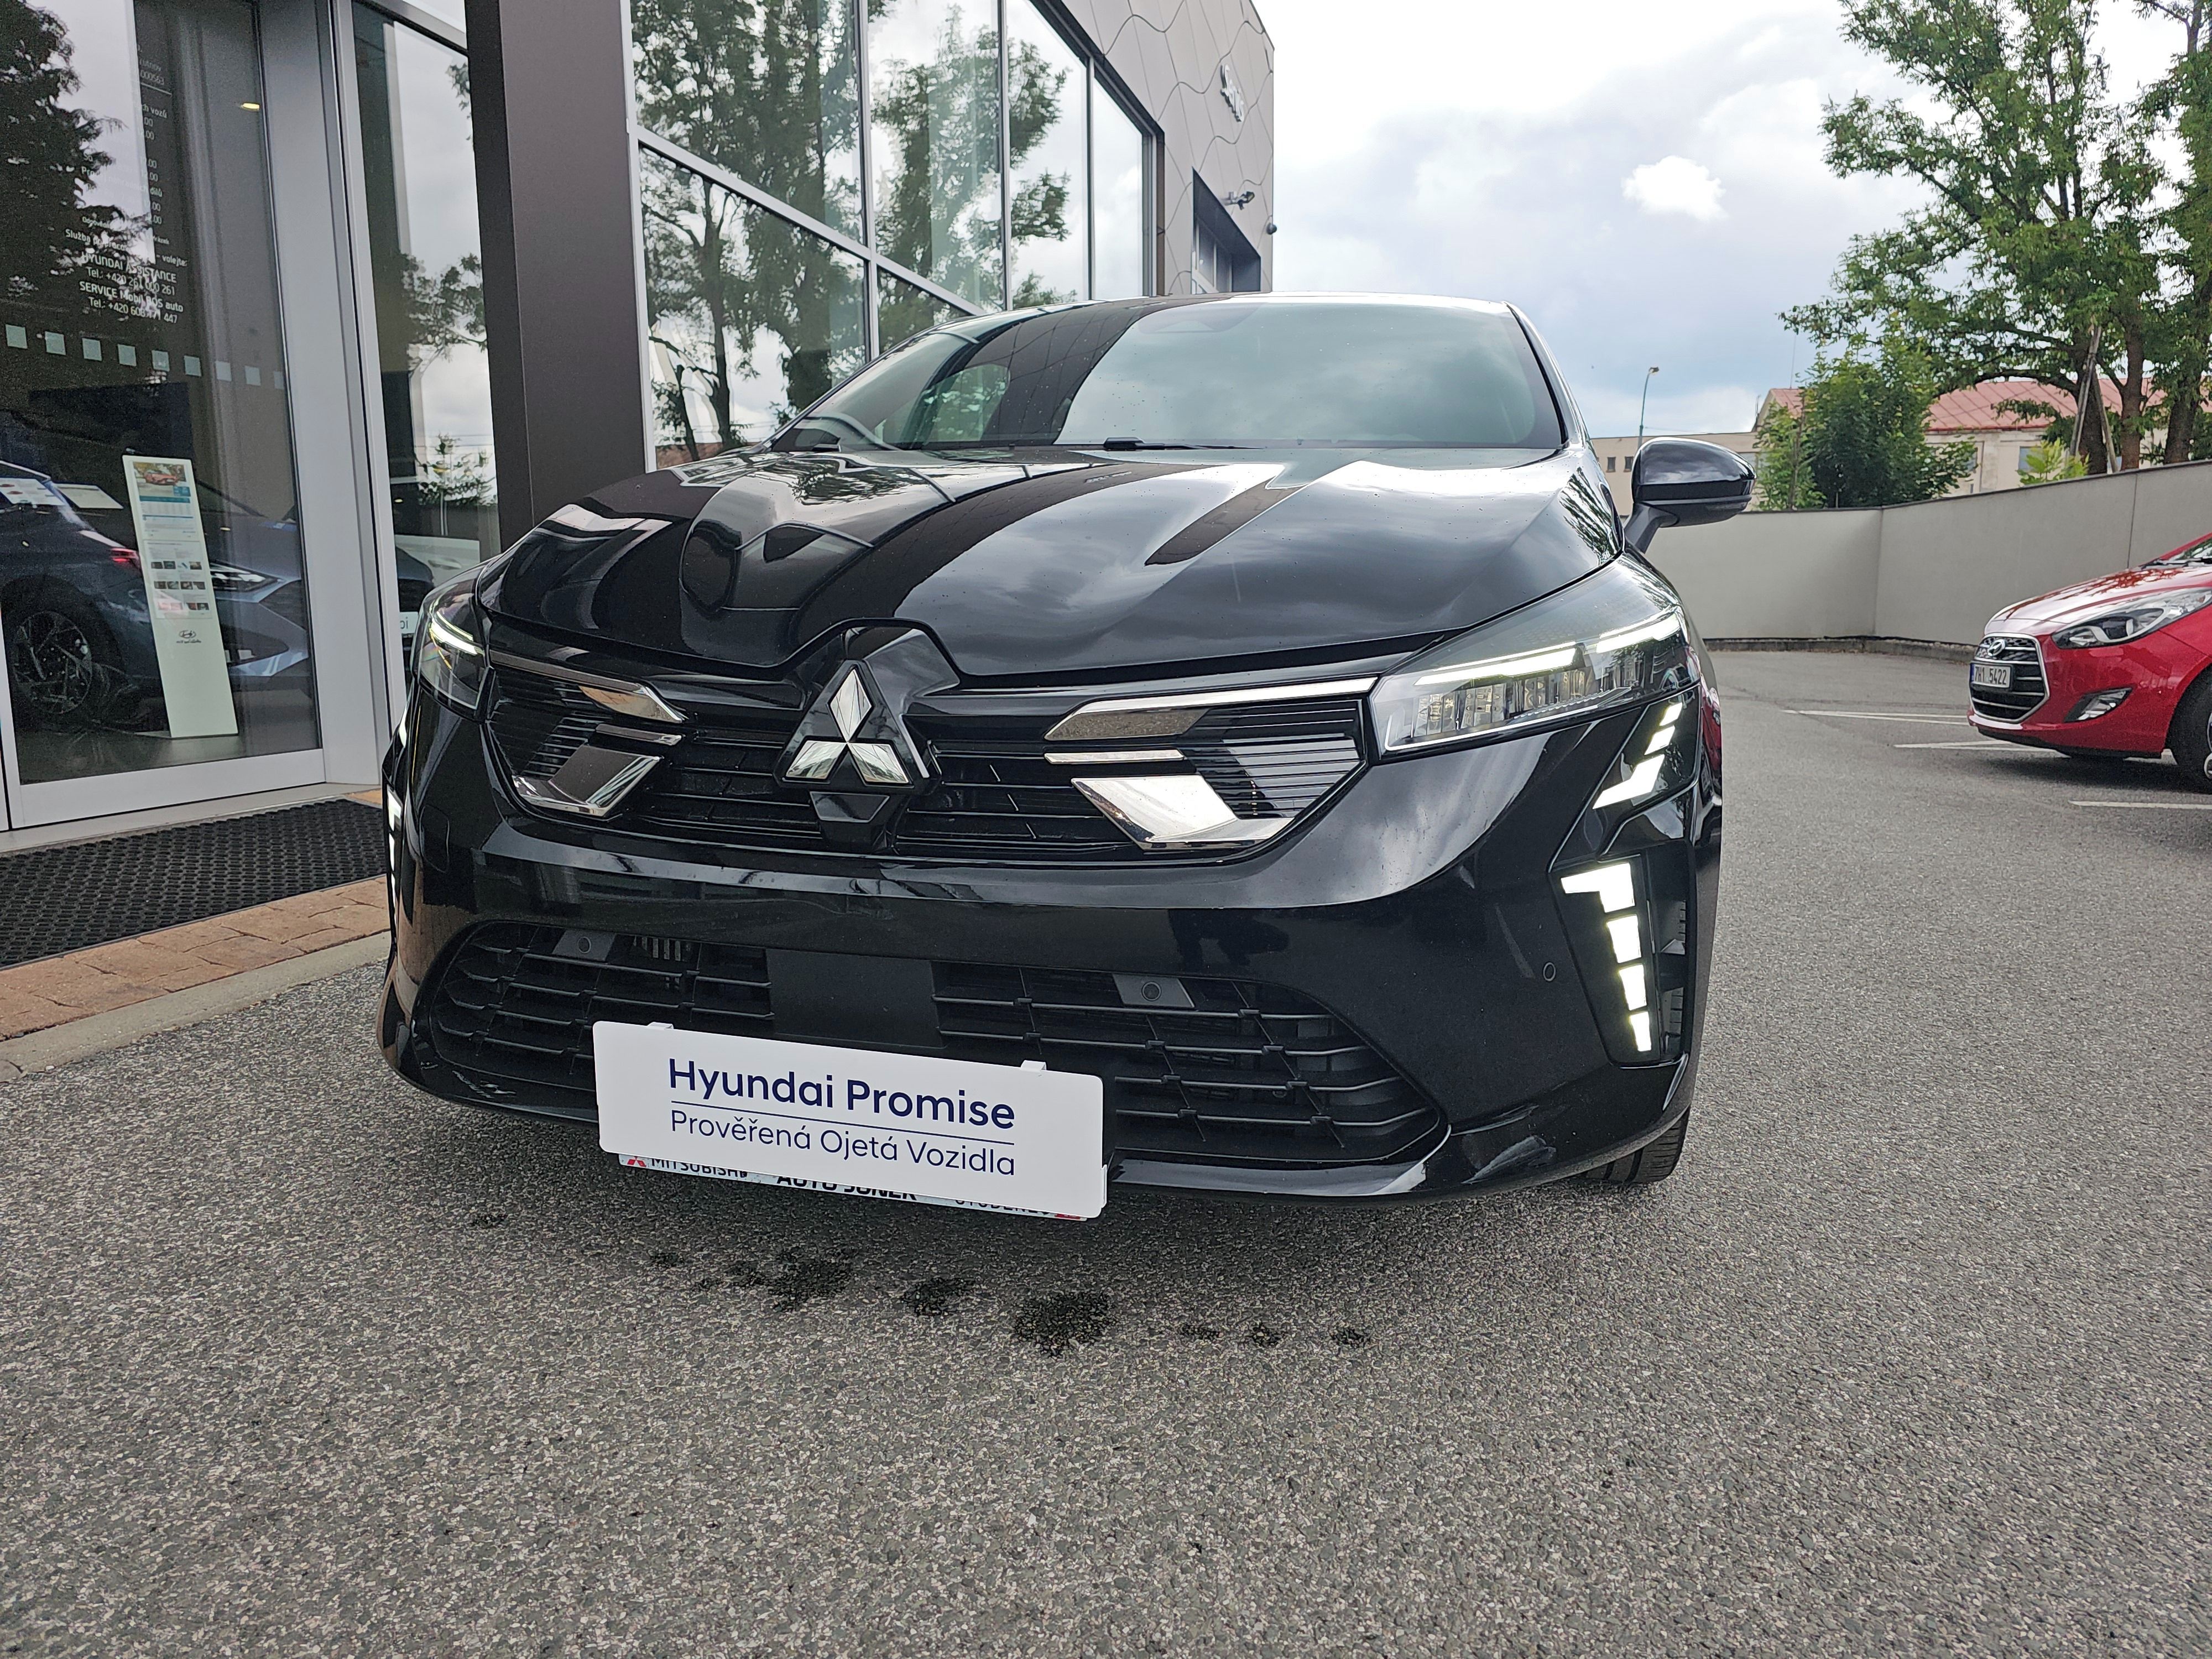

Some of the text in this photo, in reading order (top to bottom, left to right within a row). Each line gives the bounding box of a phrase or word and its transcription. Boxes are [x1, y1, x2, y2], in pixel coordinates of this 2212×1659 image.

[79, 281, 118, 299] SERVICE
[165, 301, 184, 312] auto
[106, 273, 127, 285] +420
[161, 284, 175, 296] 261
[108, 302, 128, 314] +420
[1989, 667, 2007, 685] 5422
[669, 1058, 1015, 1129] Hyundai Promise
[671, 1109, 1014, 1176] Prověřená Ojetá Vozidla
